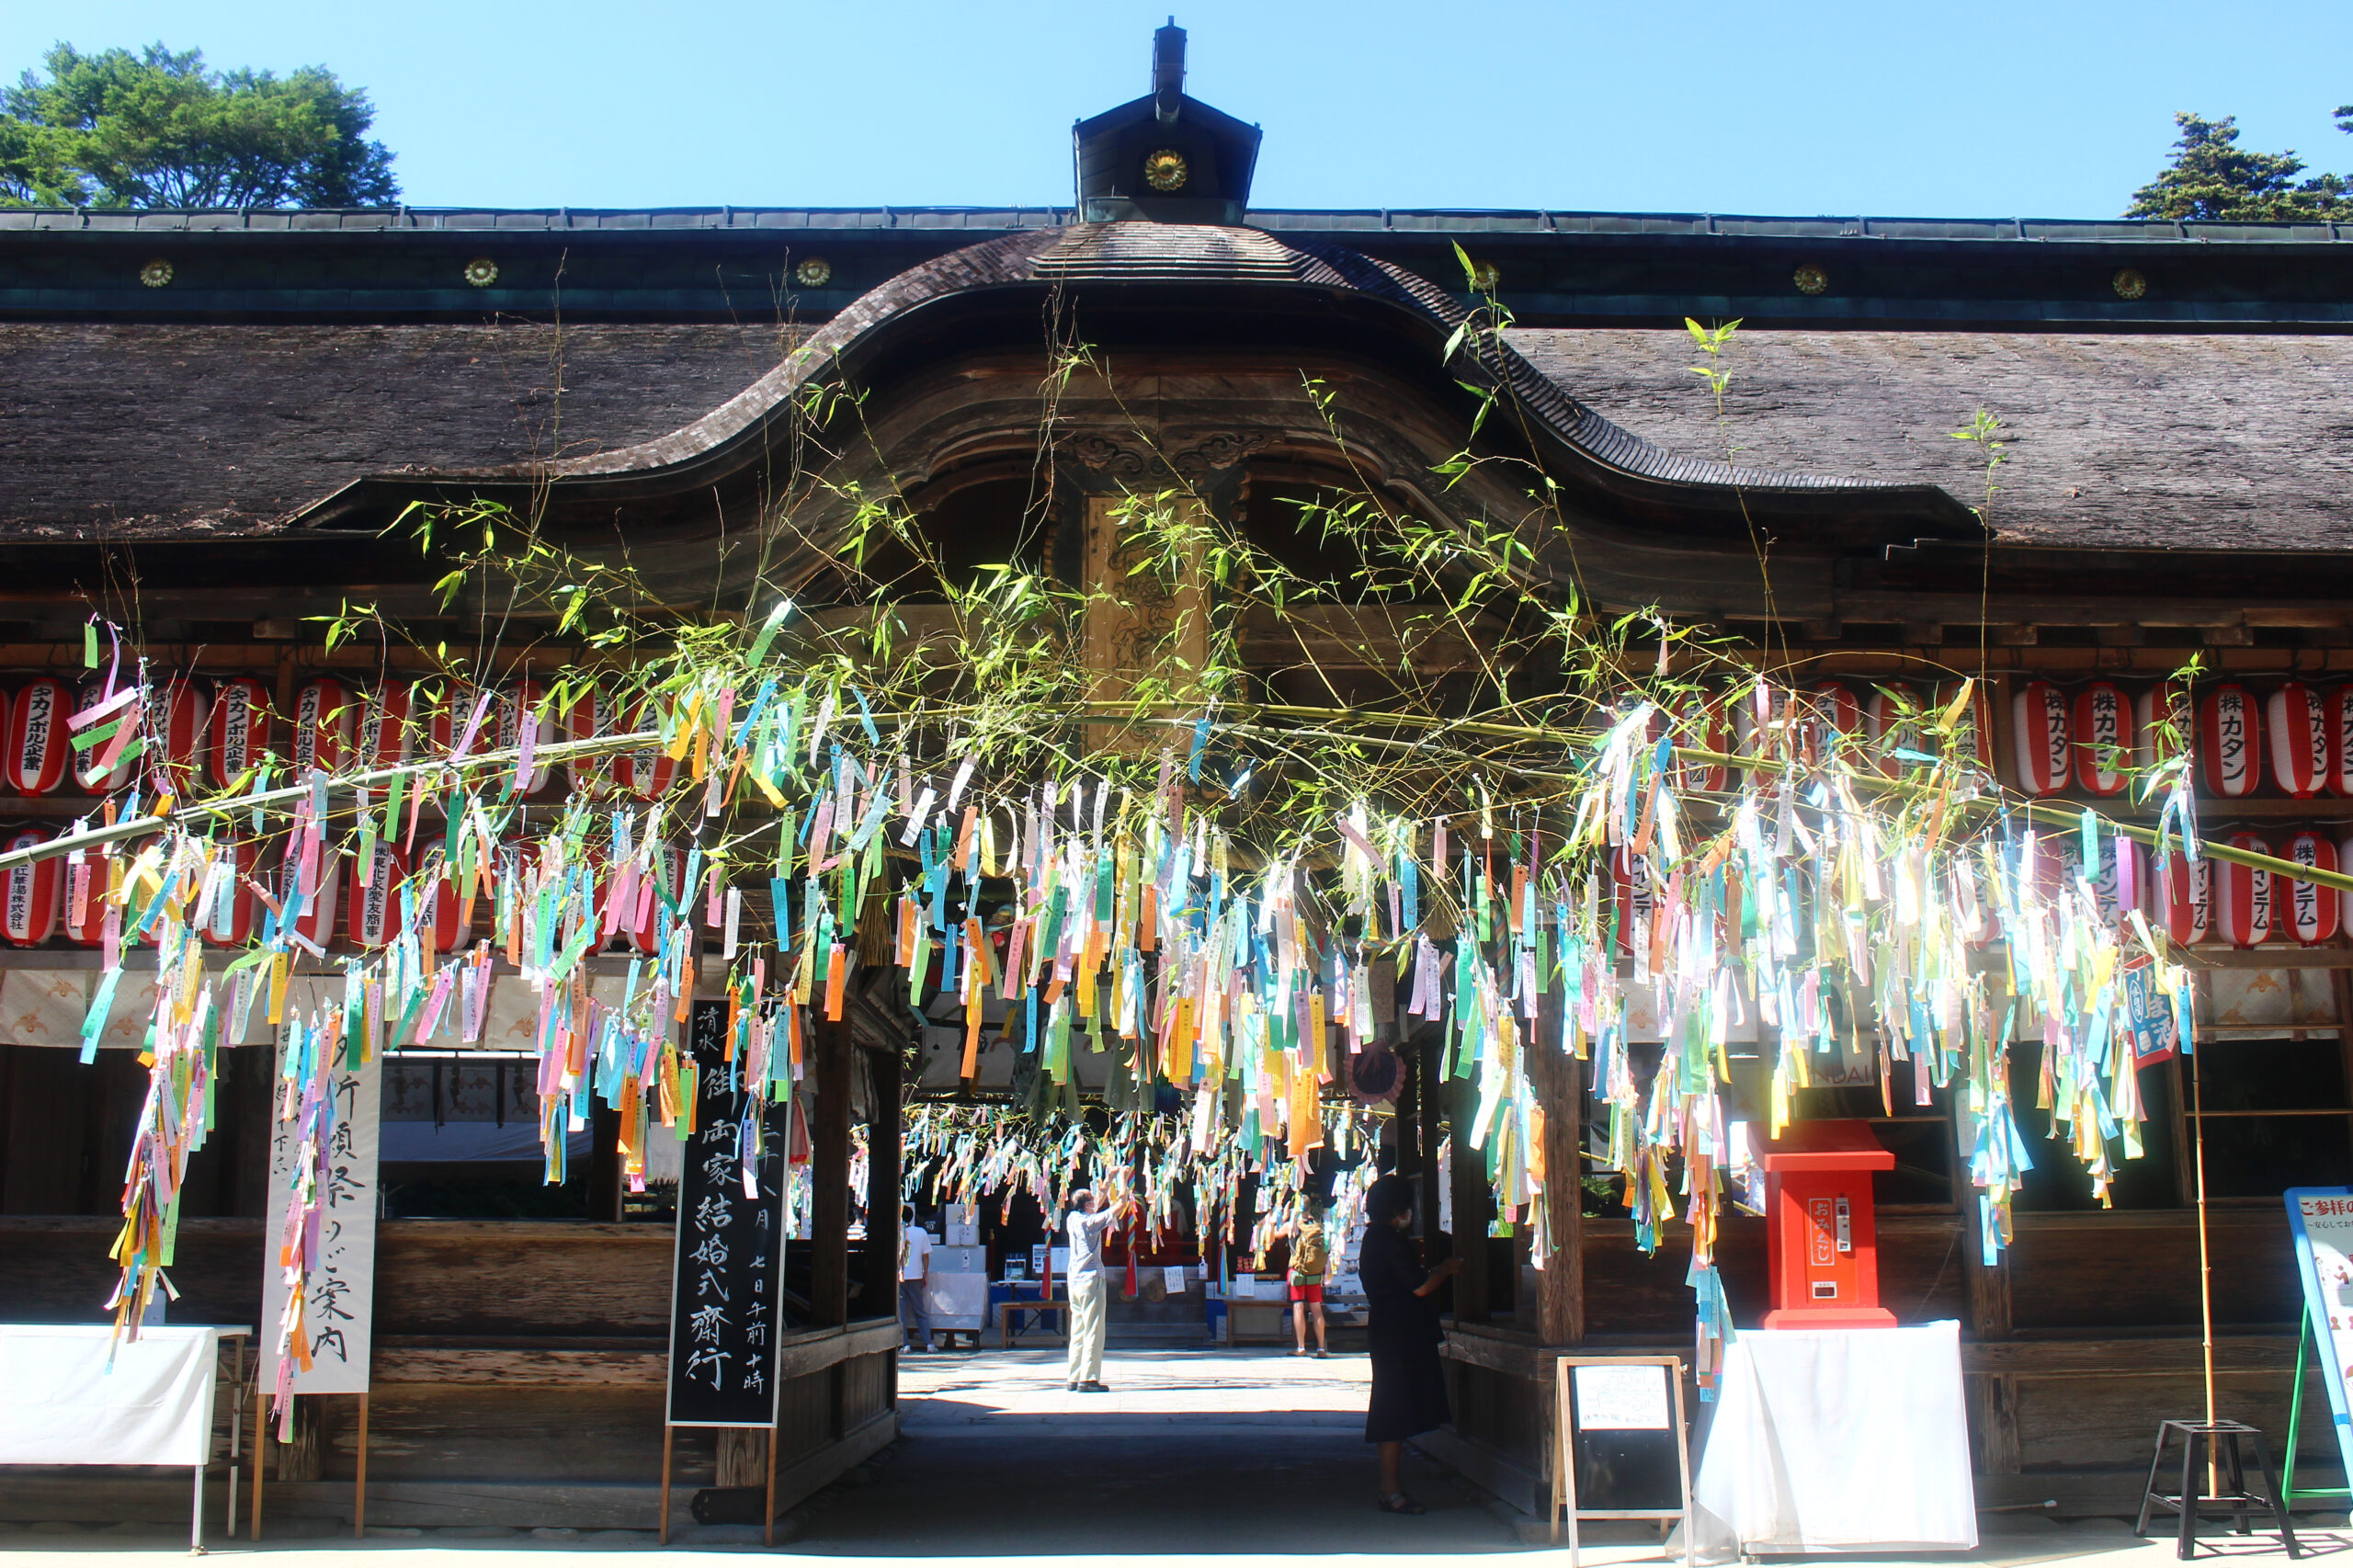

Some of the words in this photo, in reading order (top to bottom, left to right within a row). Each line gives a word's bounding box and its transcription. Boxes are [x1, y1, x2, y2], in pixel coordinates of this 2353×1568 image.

[22, 687, 52, 771] タカノボル企業
[697, 1006, 721, 1052] 清水
[1808, 1064, 1870, 1085] NDAI
[1813, 1201, 1831, 1262] おみくじ
